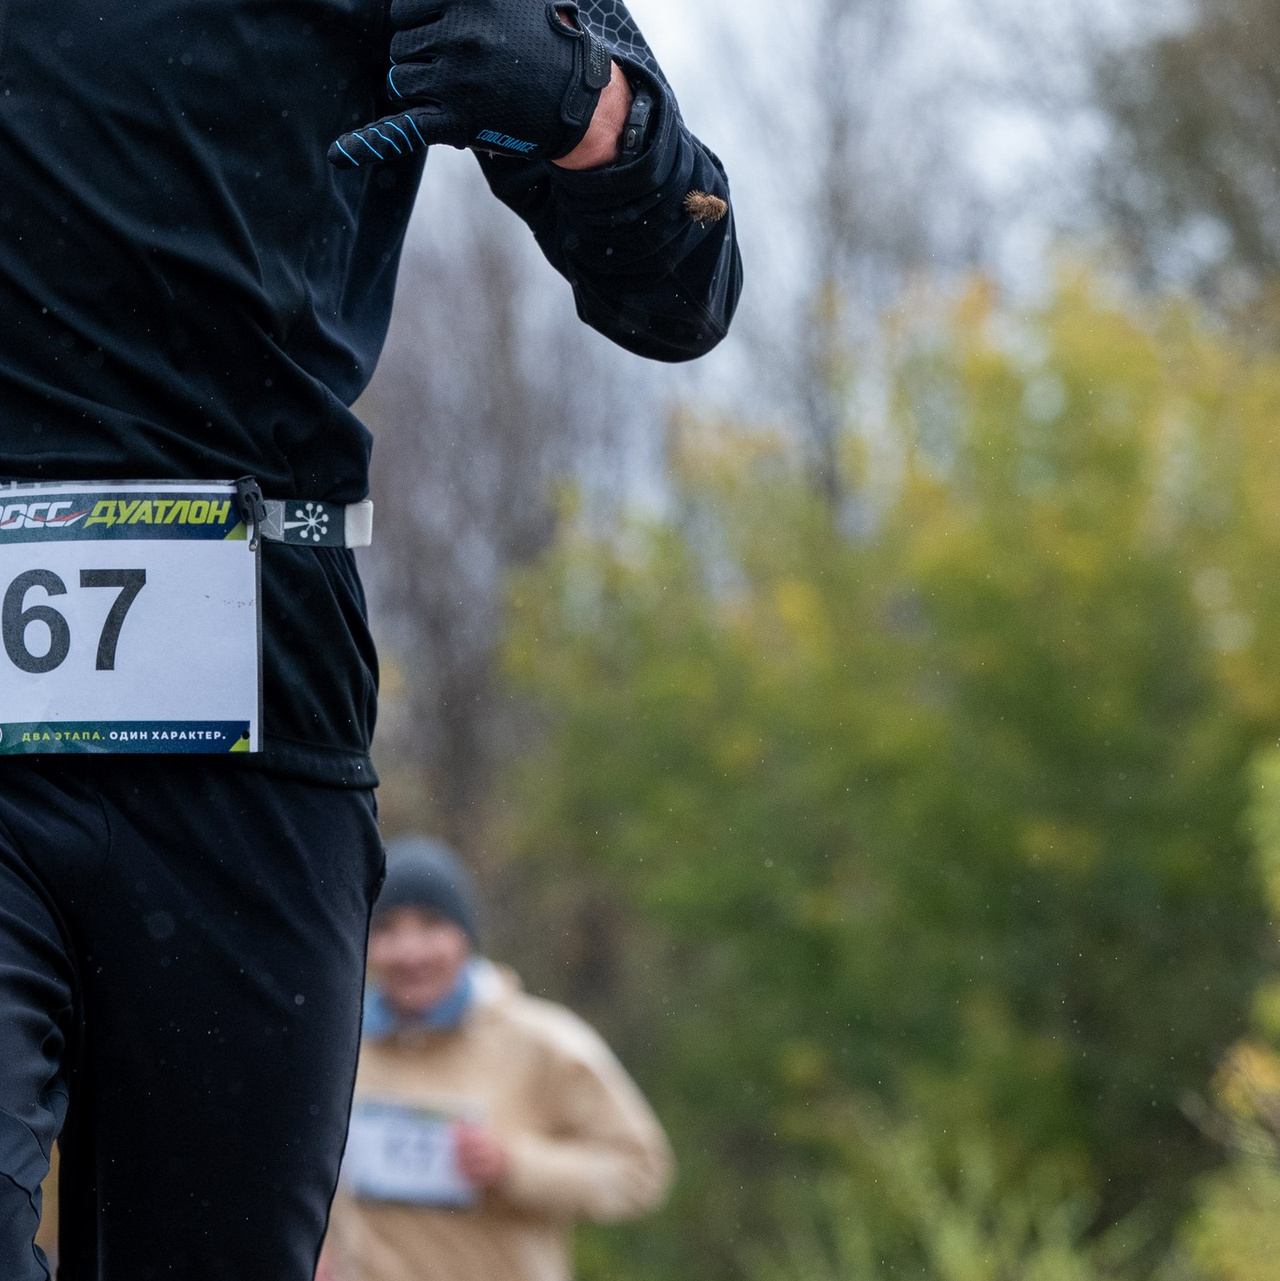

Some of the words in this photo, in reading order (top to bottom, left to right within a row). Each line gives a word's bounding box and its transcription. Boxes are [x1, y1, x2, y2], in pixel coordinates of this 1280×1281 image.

[83, 500, 231, 529] ДУАТЛОН
[2, 568, 147, 674] 67
[22, 732, 51, 742] ДВА
[54, 732, 106, 741] ЭТАПА.
[109, 731, 148, 741] ОДИН
[152, 731, 227, 740] ХАРАКТЕР.
